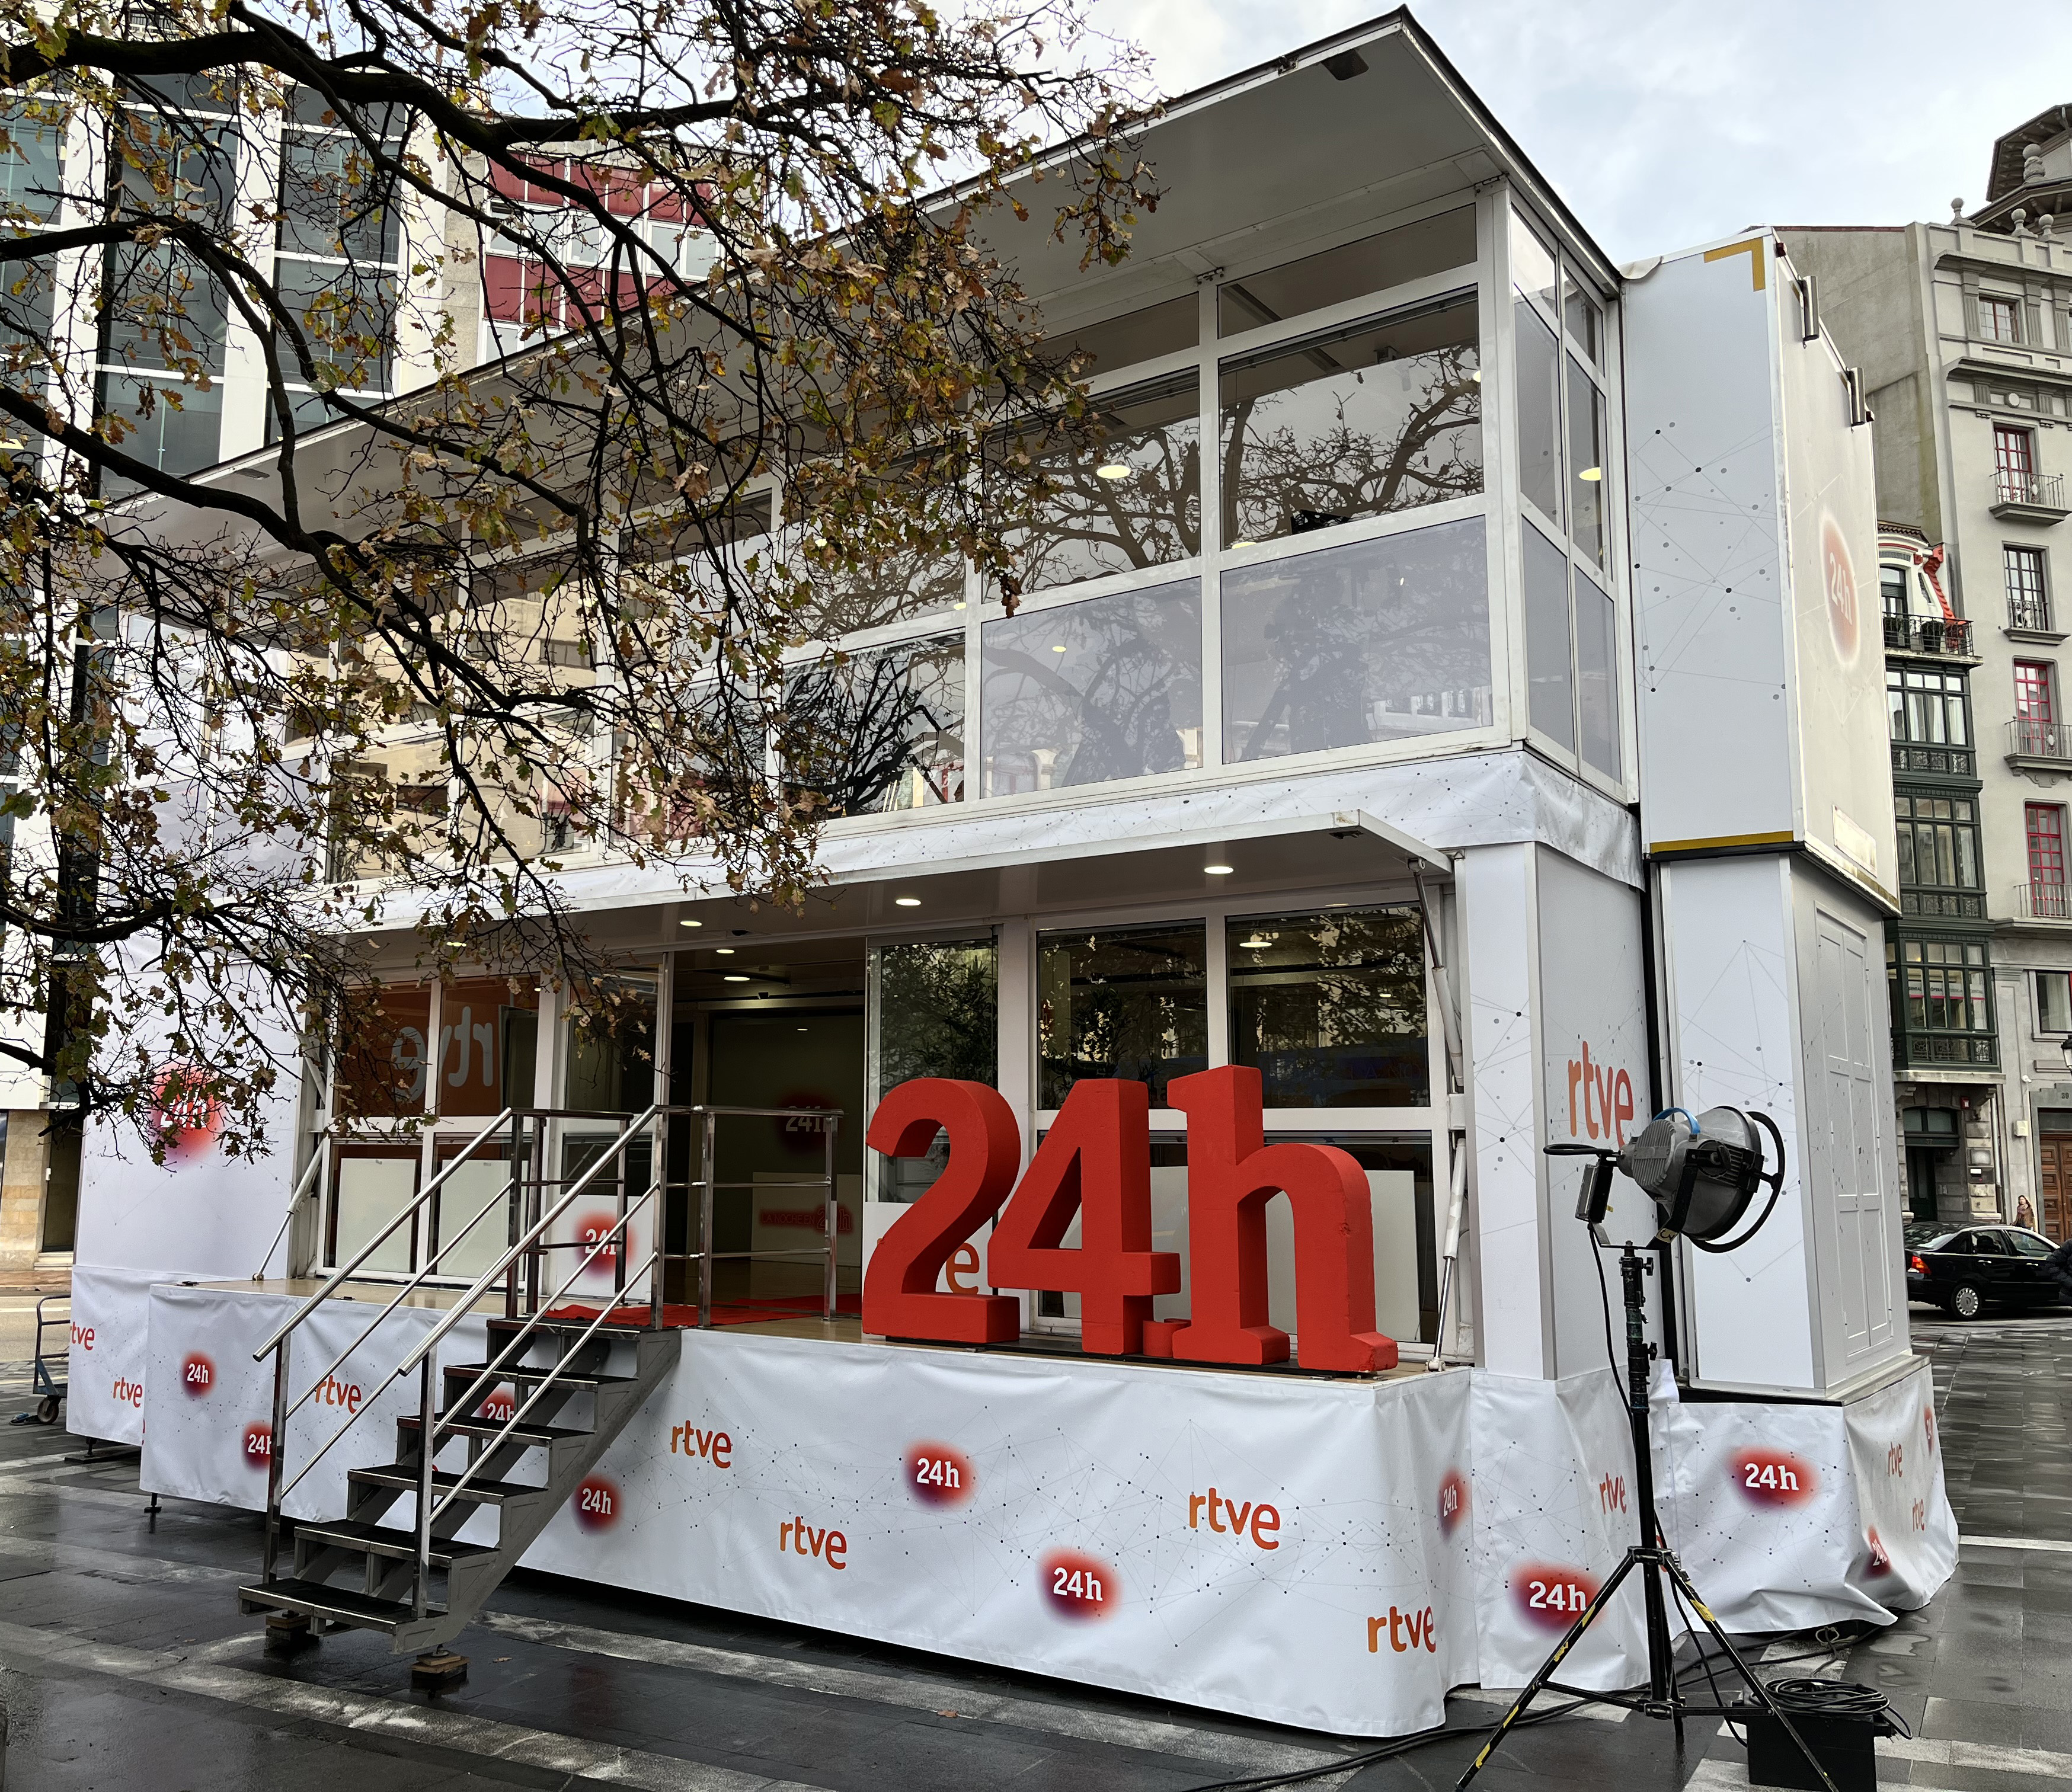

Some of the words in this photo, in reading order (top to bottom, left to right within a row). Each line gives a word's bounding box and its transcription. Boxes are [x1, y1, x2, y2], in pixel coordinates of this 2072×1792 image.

[1829, 551, 1853, 626] 24h
[1568, 1041, 1634, 1148] rtve
[817, 1208, 852, 1231] 2h
[862, 1064, 1398, 1373] 24h
[69, 1321, 95, 1351] tve
[187, 1364, 209, 1384] 24h
[113, 1377, 143, 1408] rtve
[315, 1375, 362, 1415] rtve
[671, 1420, 731, 1468] rtve
[1888, 1441, 1902, 1477] rtve
[916, 1458, 961, 1488] 24h
[1744, 1463, 1799, 1491] 24h
[581, 1487, 612, 1515] 24h
[1443, 1484, 1457, 1517] 24h
[1599, 1472, 1627, 1515] rtve
[1189, 1487, 1280, 1550] rtve
[779, 1516, 846, 1570] rtve
[1053, 1567, 1103, 1602] 24h
[1529, 1581, 1587, 1612] 24h
[1367, 1605, 1436, 1653] rtve
